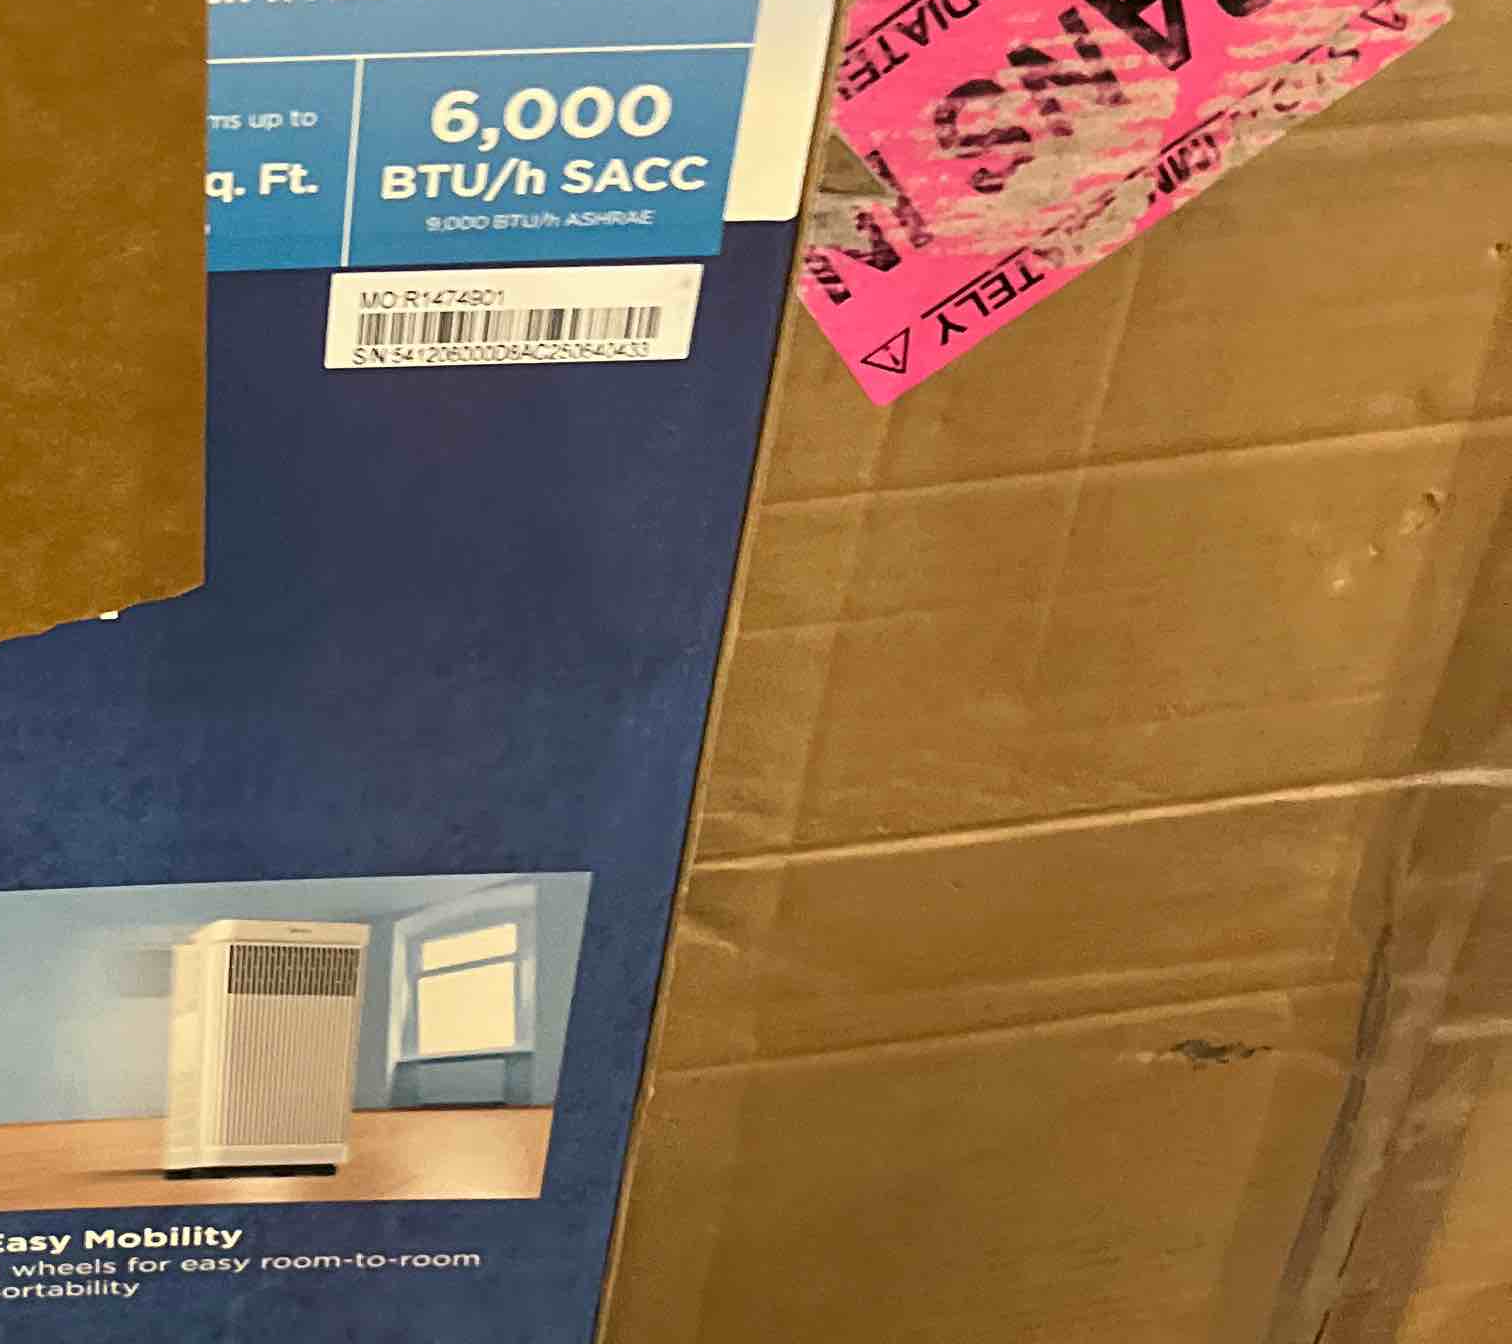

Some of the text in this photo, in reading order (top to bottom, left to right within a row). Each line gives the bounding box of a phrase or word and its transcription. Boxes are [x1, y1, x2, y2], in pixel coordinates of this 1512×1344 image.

[290, 109, 319, 129] to
[430, 83, 673, 151] 6,000
[259, 162, 319, 195] Ft.
[379, 155, 709, 204] BTU/h SACC
[84, 1224, 244, 1253] Mobility
[12, 1256, 118, 1278] wheels
[127, 1254, 173, 1275] for
[180, 1256, 251, 1276] easy
[260, 1250, 482, 1270] room-to-room
